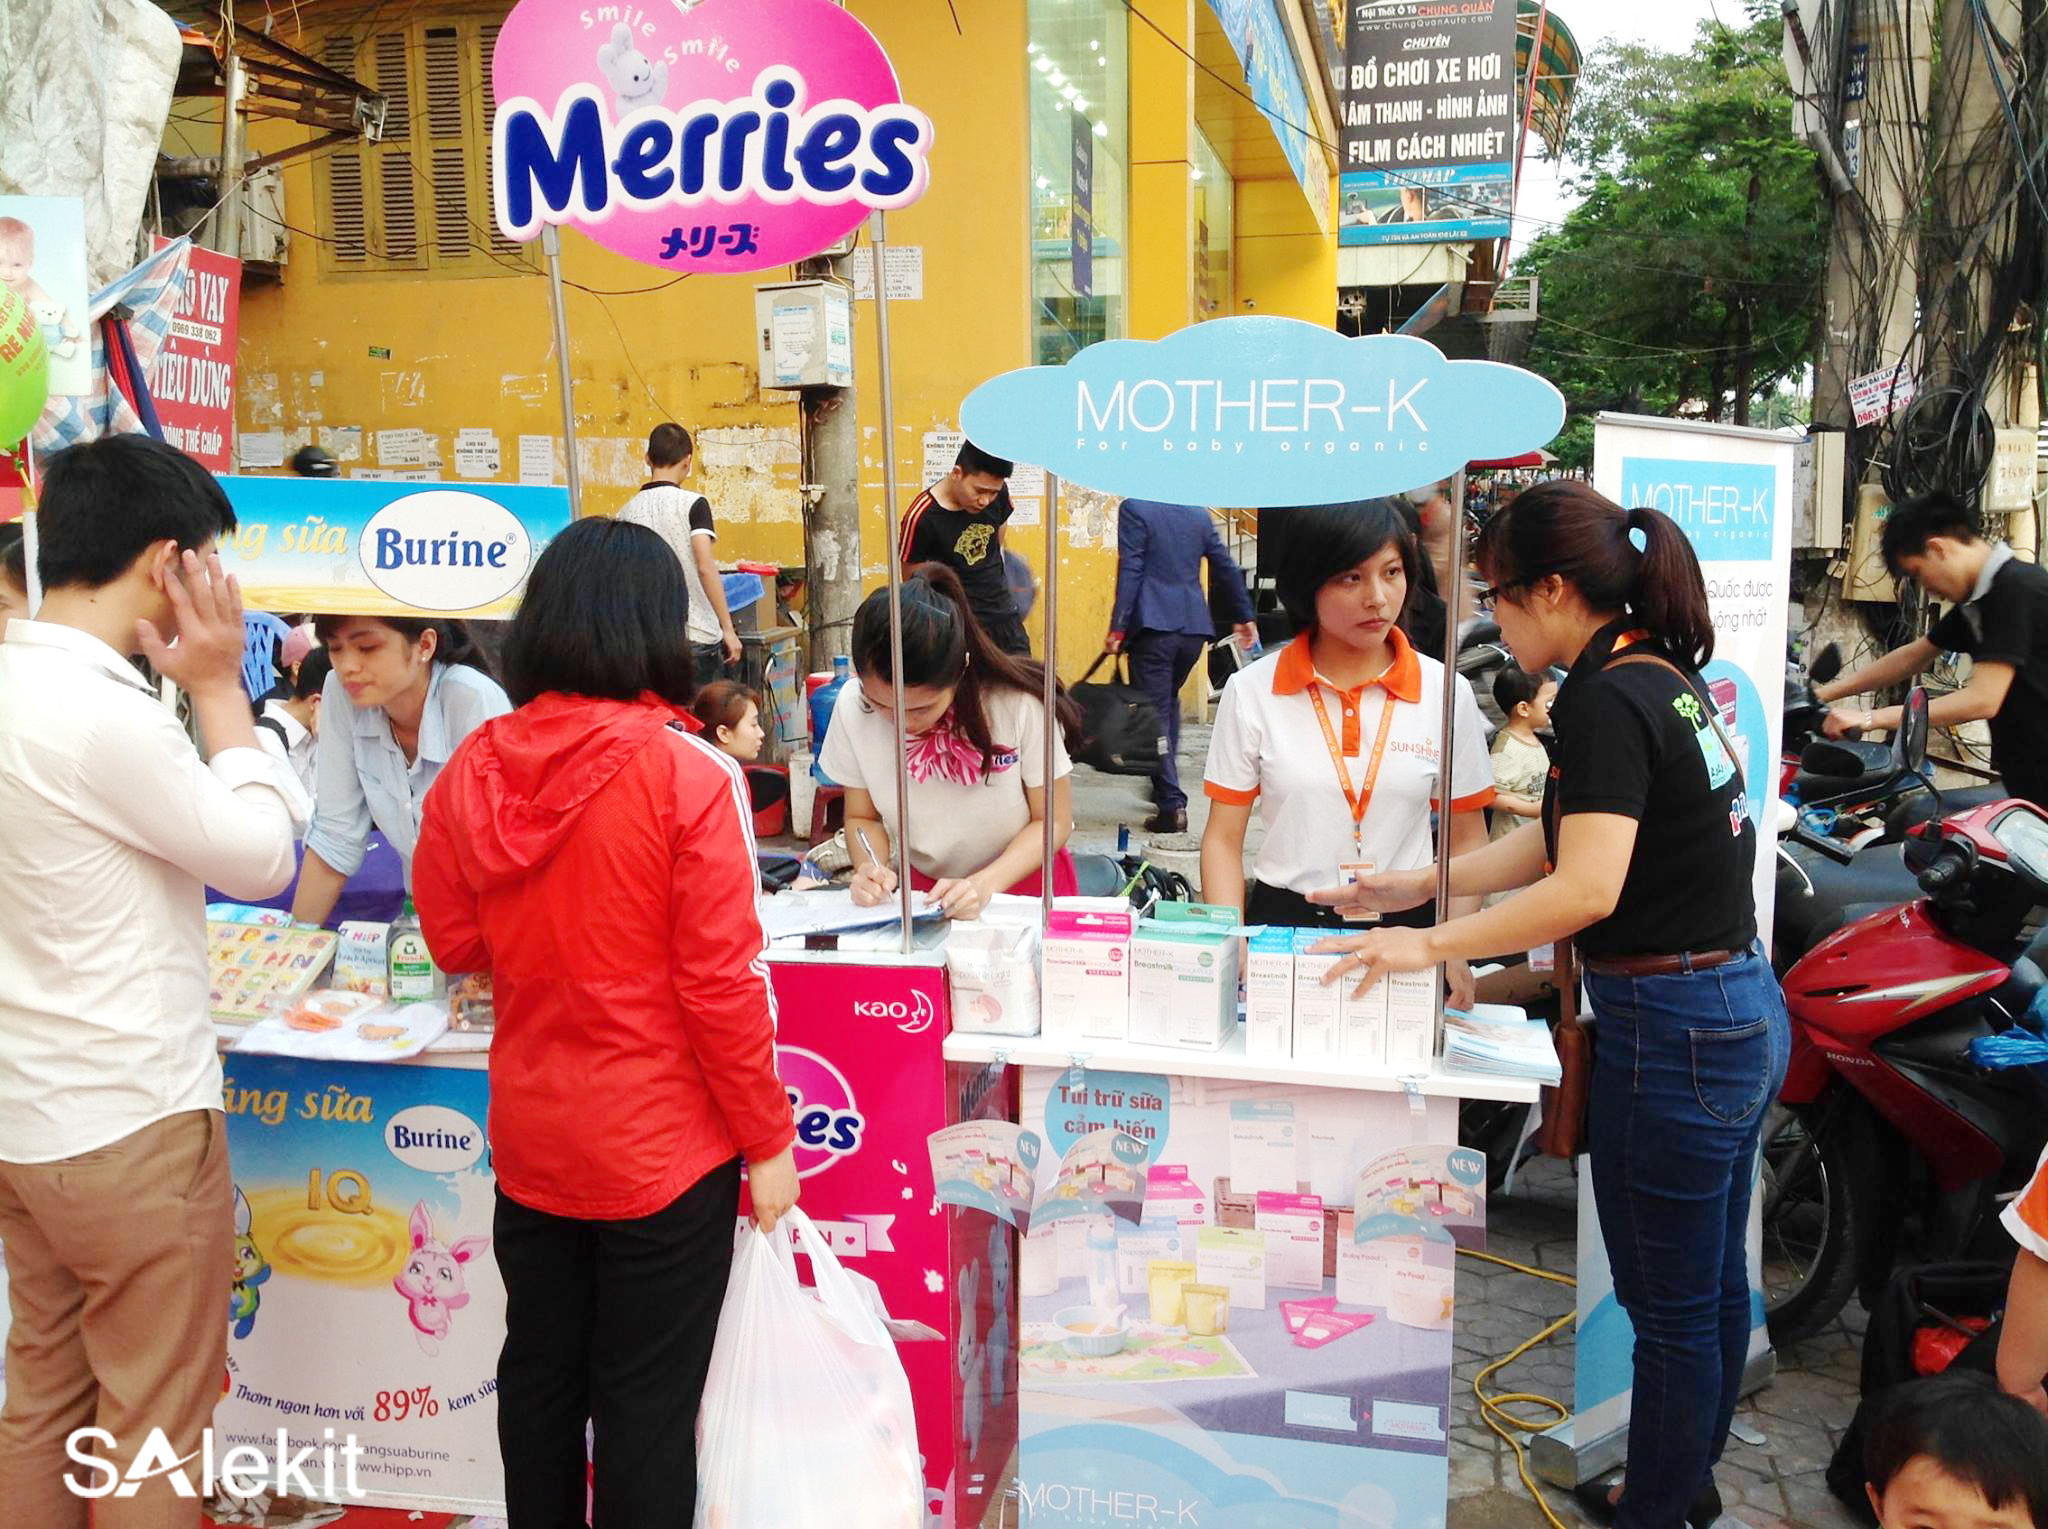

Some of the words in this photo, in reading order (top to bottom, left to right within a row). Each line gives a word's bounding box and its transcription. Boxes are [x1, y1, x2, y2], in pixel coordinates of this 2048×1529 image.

[1417, 4, 1457, 17] CHUNG
[1402, 33, 1451, 49] CHUYÊN
[1351, 56, 1378, 90] ĐỒ
[1384, 58, 1430, 87] CHƠI
[1436, 58, 1461, 83] XE
[1467, 52, 1501, 81] HƠI
[1347, 101, 1371, 126] ÂM
[1375, 100, 1422, 124] THANH
[1437, 93, 1473, 120] HÌNH
[1477, 88, 1508, 116] ẢNH
[505, 79, 919, 227] Merries
[1349, 138, 1391, 163] FILM
[1396, 132, 1445, 160] CÁCH
[1452, 127, 1505, 160] NHIỆT
[659, 224, 760, 260] メリーズ
[200, 272, 229, 323] VAY
[190, 346, 231, 410] DÙNG
[1077, 379, 1429, 432] MOTHER-K
[1077, 438, 1129, 452] For
[1163, 438, 1244, 454] baby
[1281, 438, 1429, 454] organic
[279, 516, 348, 555] sữa
[375, 528, 508, 570] Burine
[1707, 580, 1740, 599] Quốc
[1744, 580, 1773, 600] được
[1742, 607, 1767, 628] nhất
[1826, 1052, 1875, 1067] HONDA
[223, 1079, 289, 1125] áng
[300, 1084, 374, 1123] sữa
[394, 1125, 472, 1151] Burine
[1020, 1138, 1040, 1159] NEW
[1115, 1139, 1144, 1156] NEW
[1451, 1157, 1481, 1175] NEW
[307, 1167, 374, 1216] IQ
[236, 1383, 272, 1407] Thơm
[275, 1398, 310, 1415] ngon
[314, 1403, 340, 1419] hơn
[344, 1406, 365, 1421] với
[373, 1385, 439, 1422] 89%
[447, 1393, 477, 1412] kem
[1018, 1479, 1200, 1527] MOTHER-K
